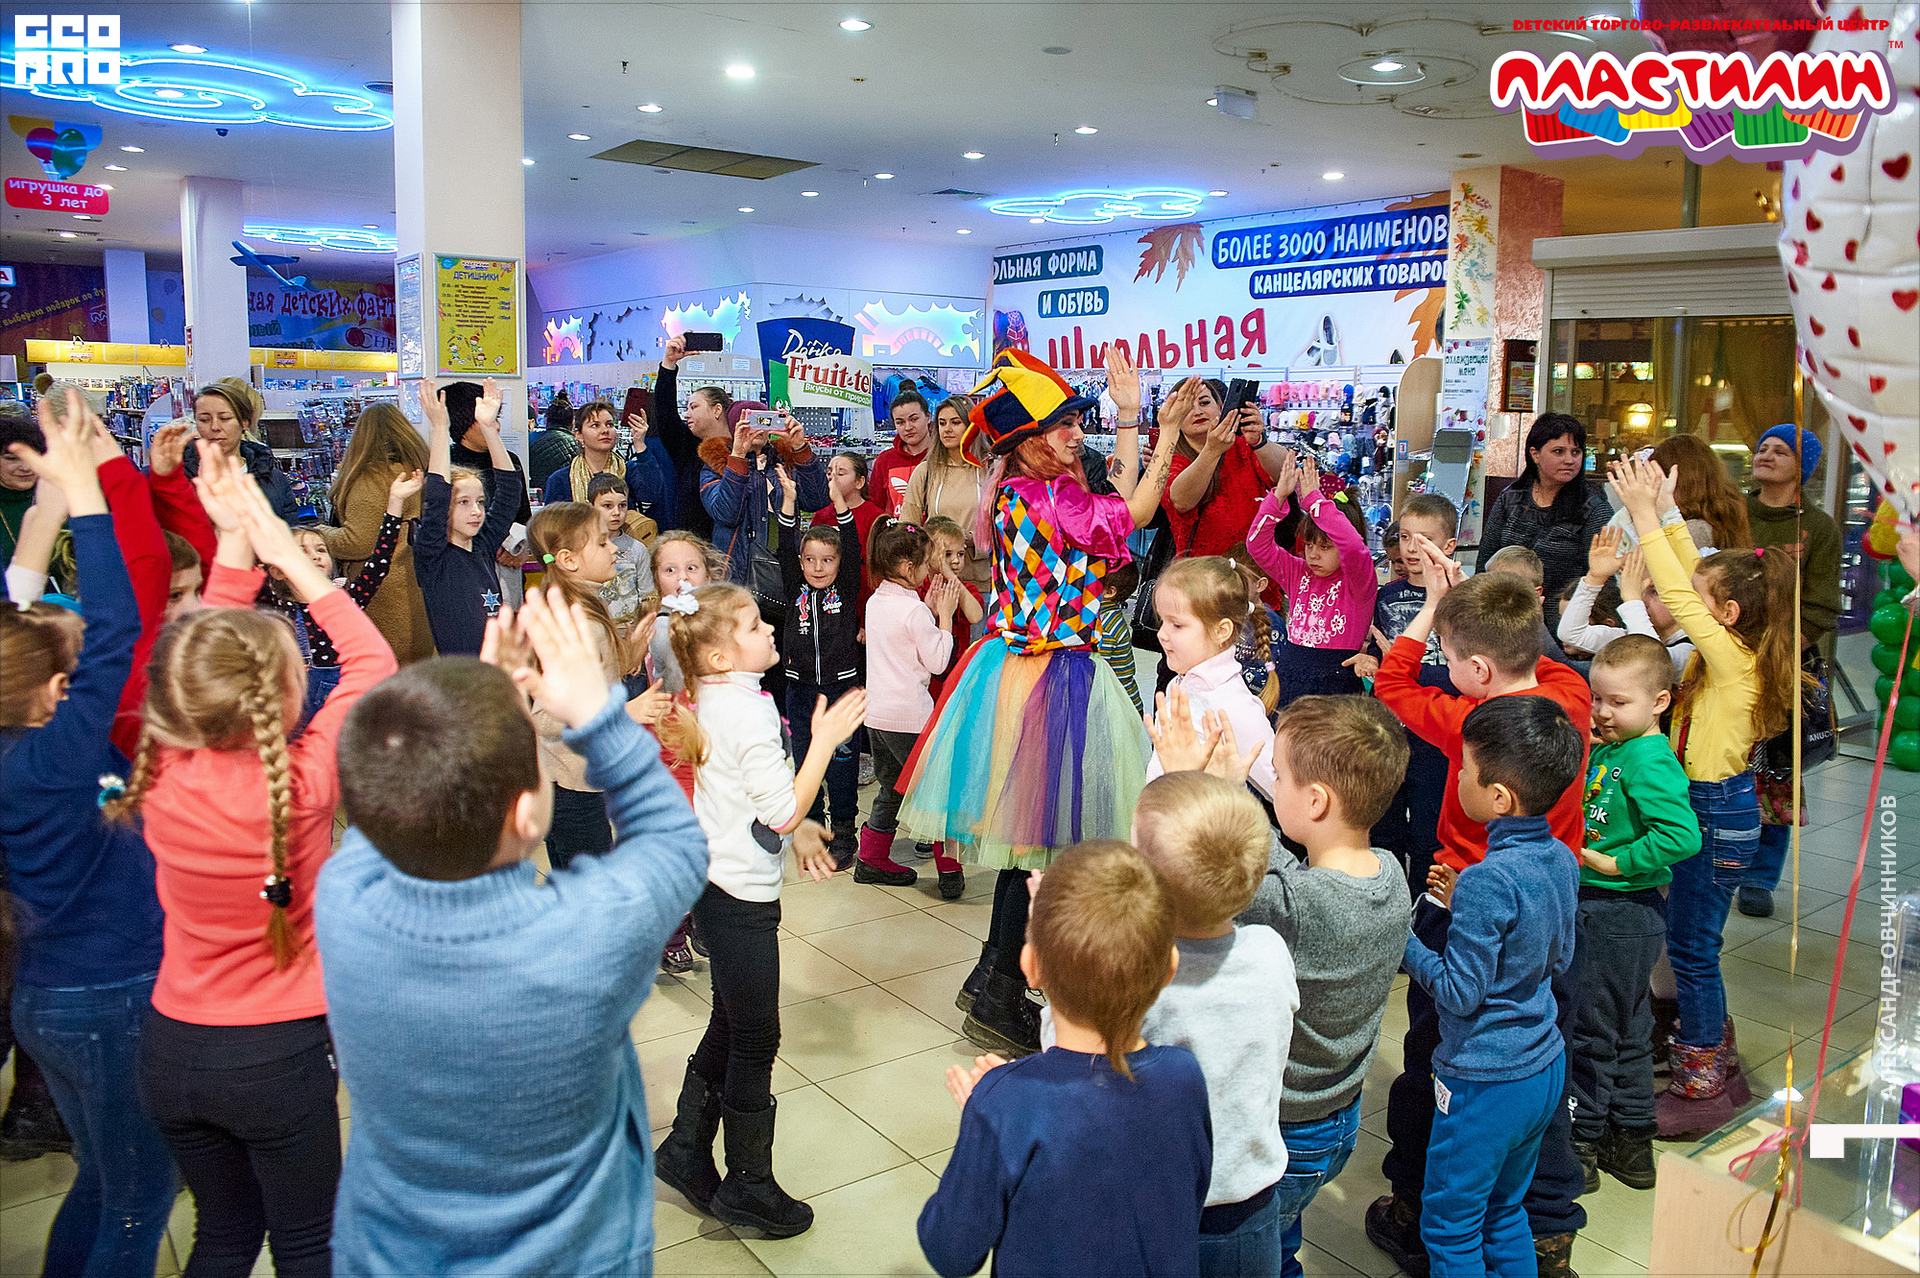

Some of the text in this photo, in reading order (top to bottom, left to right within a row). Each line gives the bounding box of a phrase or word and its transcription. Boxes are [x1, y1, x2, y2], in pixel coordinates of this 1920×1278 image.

[9, 179, 103, 197] игрушка до
[42, 193, 88, 209] 3 лет
[1218, 214, 1449, 263] БОЛЕЕ 3000 НАИМЕНОВ
[1047, 250, 1097, 275] ФОРМА
[93, 287, 106, 297] ду
[1254, 267, 1374, 294] КАНЦЕЛЯРСКИХ
[282, 292, 351, 317] детских
[1042, 289, 1104, 315] И ОБУВЬ
[833, 389, 844, 397] от
